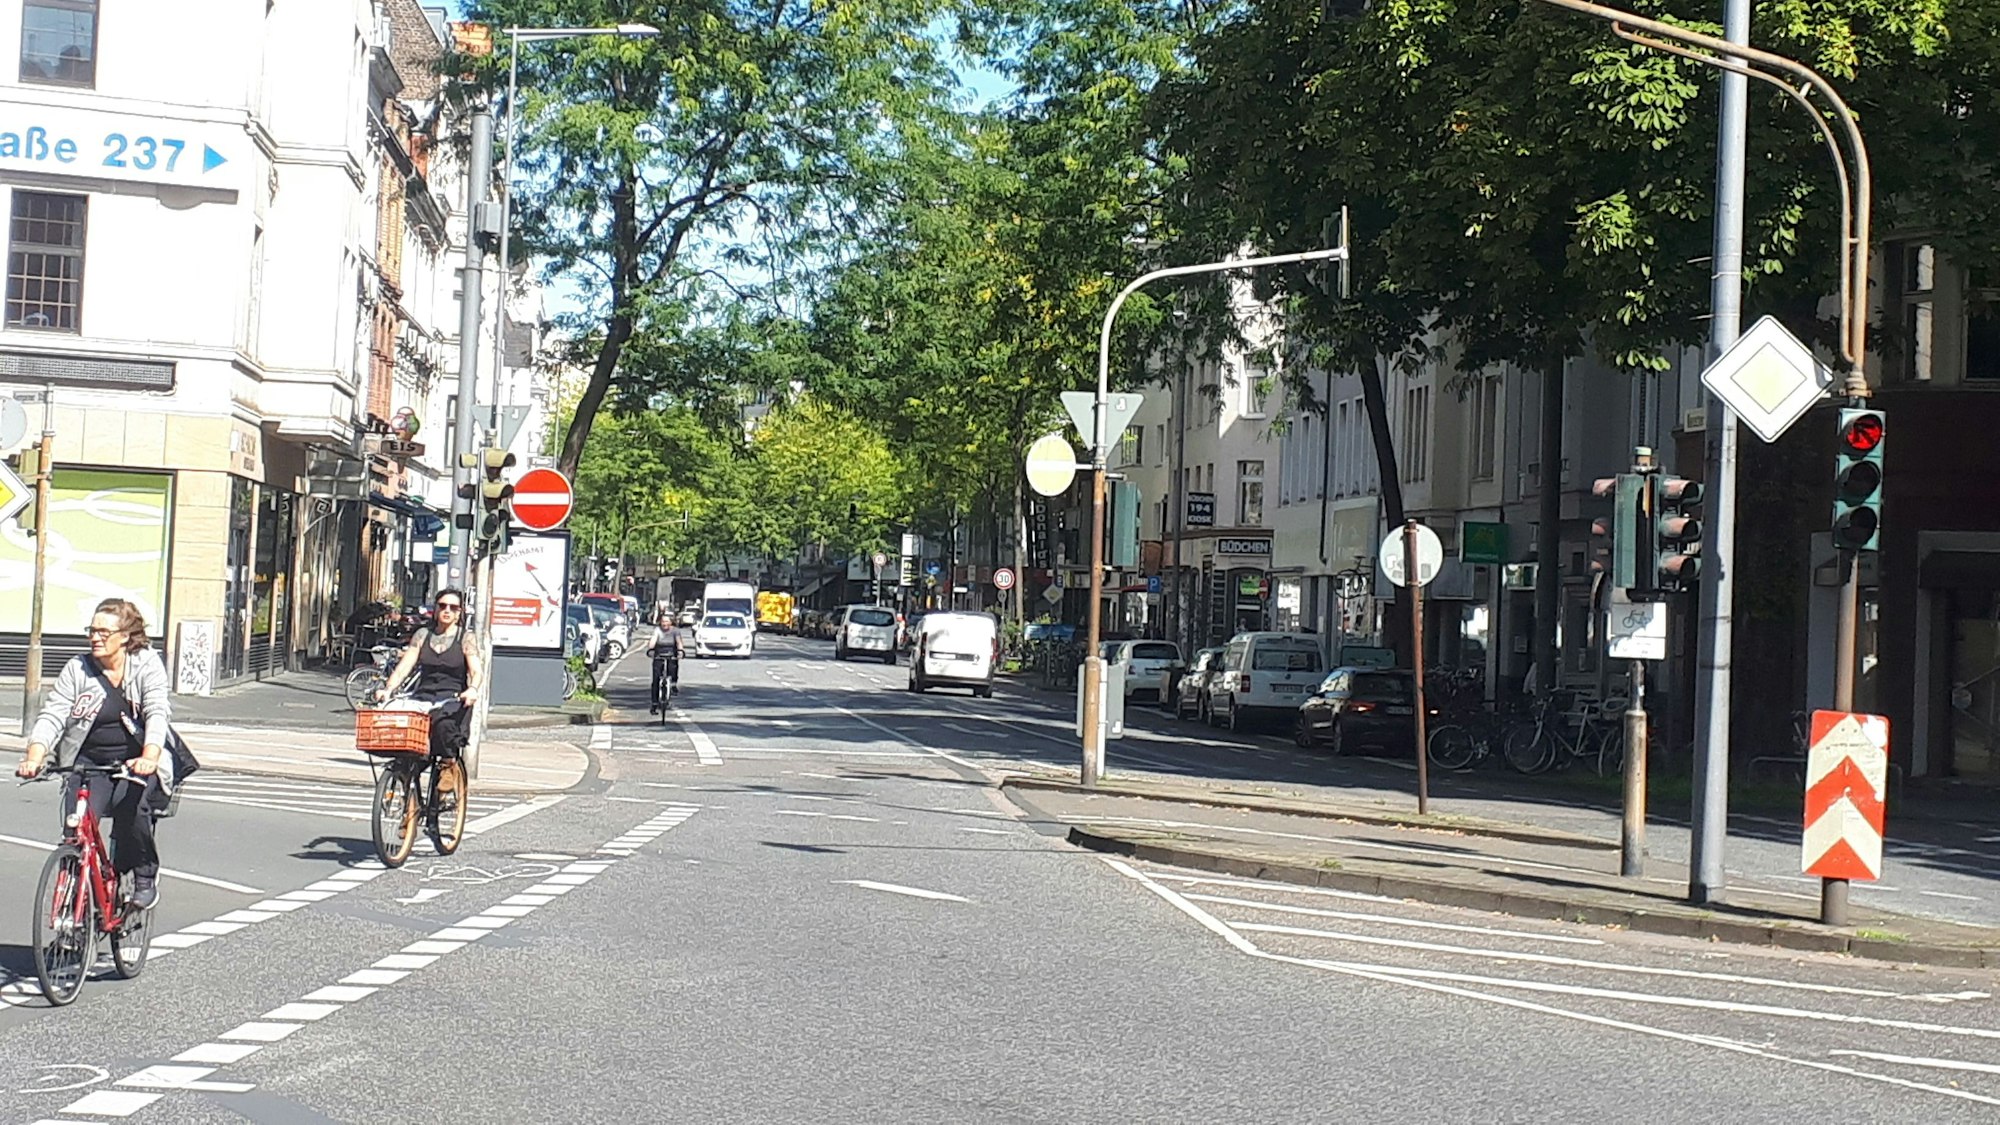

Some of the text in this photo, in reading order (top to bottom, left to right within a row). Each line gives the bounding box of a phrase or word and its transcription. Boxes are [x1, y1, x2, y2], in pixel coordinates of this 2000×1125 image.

[101, 132, 186, 172] 237
[390, 440, 416, 452] EIS
[1190, 503, 1211, 513] 194
[1188, 514, 1212, 523] KIOSK
[1220, 540, 1269, 553] BÜDCHEN
[998, 574, 1010, 584] 30
